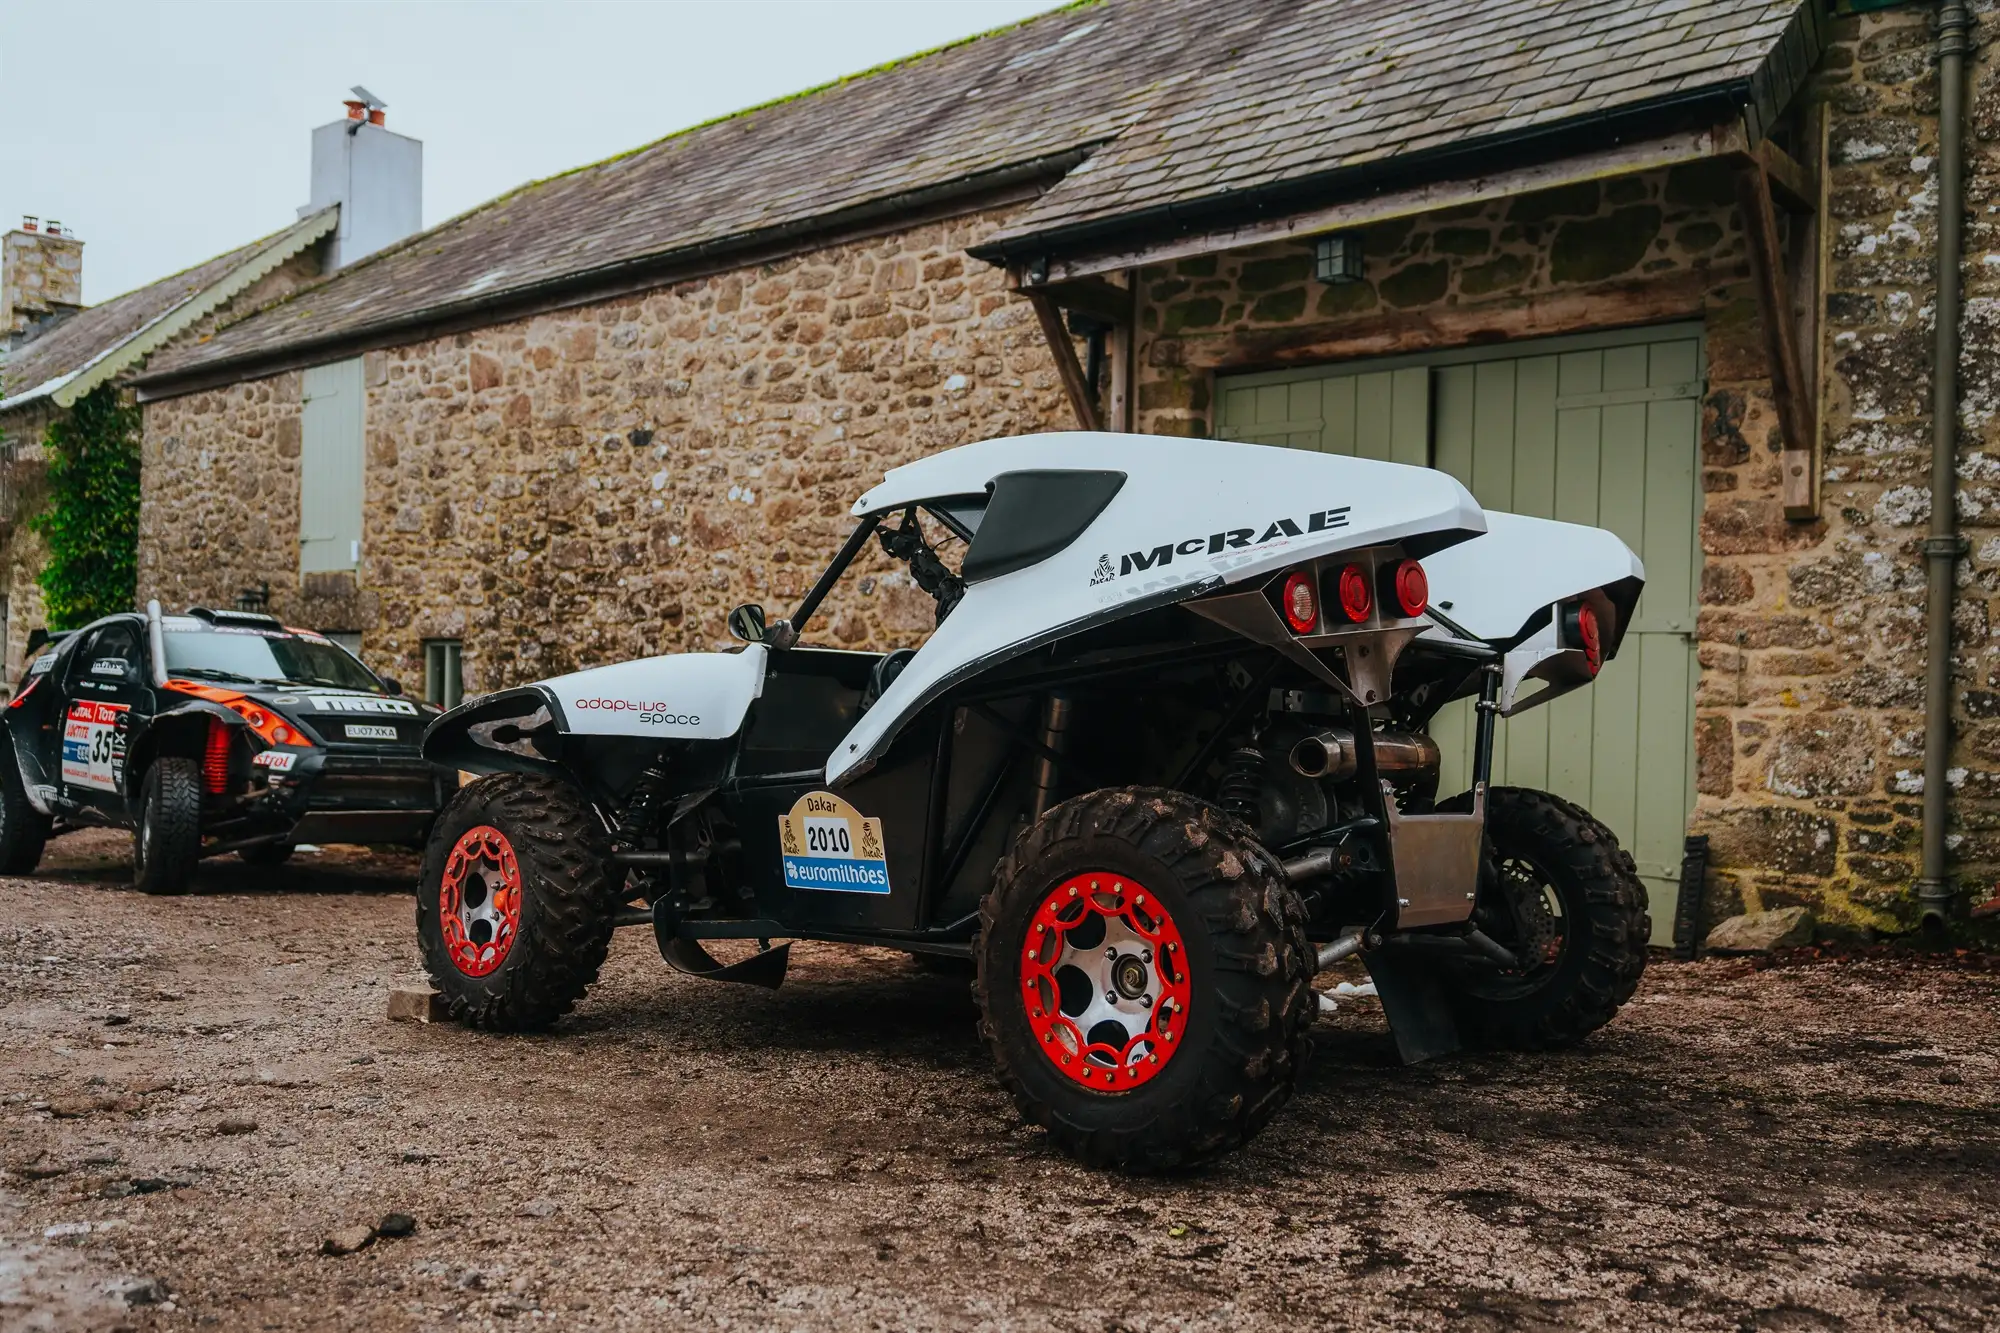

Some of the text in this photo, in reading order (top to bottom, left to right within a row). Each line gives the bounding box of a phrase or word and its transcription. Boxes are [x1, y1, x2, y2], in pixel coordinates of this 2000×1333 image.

[308, 695, 419, 716] PIRELLI
[575, 697, 667, 713] adaptive
[98, 706, 116, 722] TOTA
[639, 712, 701, 726] space
[347, 726, 396, 737] EU07 XKA
[92, 729, 112, 764] 35
[253, 753, 289, 768] strol
[807, 797, 837, 813] Dakar
[808, 826, 850, 853] 2010
[799, 864, 886, 885] euromilhões
